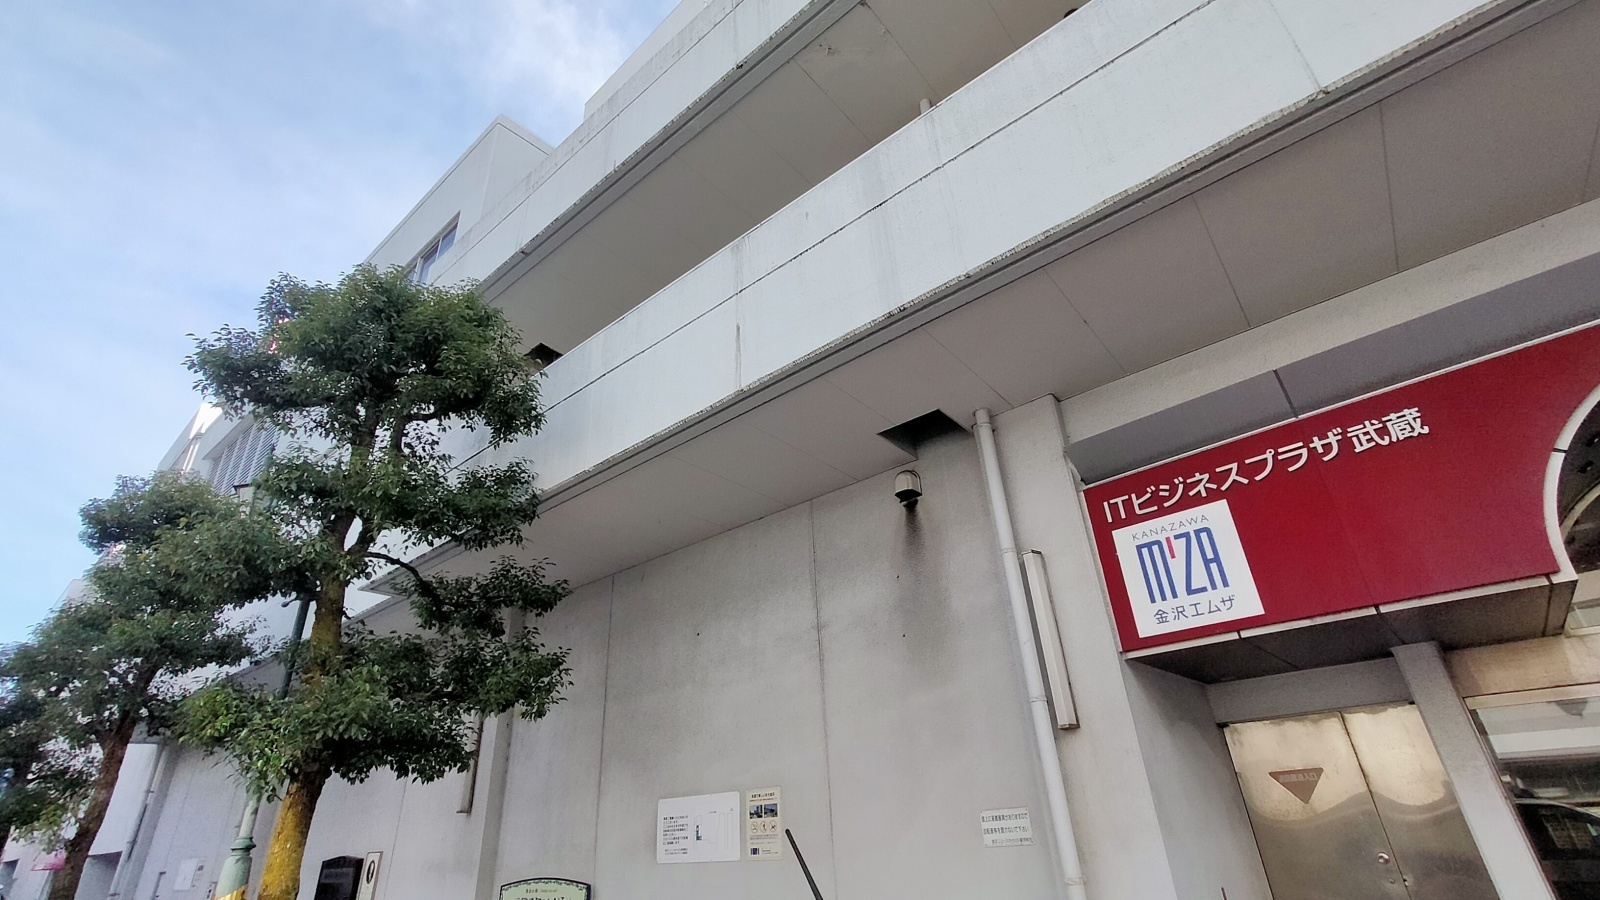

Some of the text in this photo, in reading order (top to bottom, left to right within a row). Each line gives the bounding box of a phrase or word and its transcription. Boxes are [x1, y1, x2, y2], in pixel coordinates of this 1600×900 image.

[1102, 407, 1430, 523] ITビジネスプラザ武蔵
[1132, 514, 1210, 542] KANAZAWA
[1153, 594, 1236, 625] 金沢エムザ
